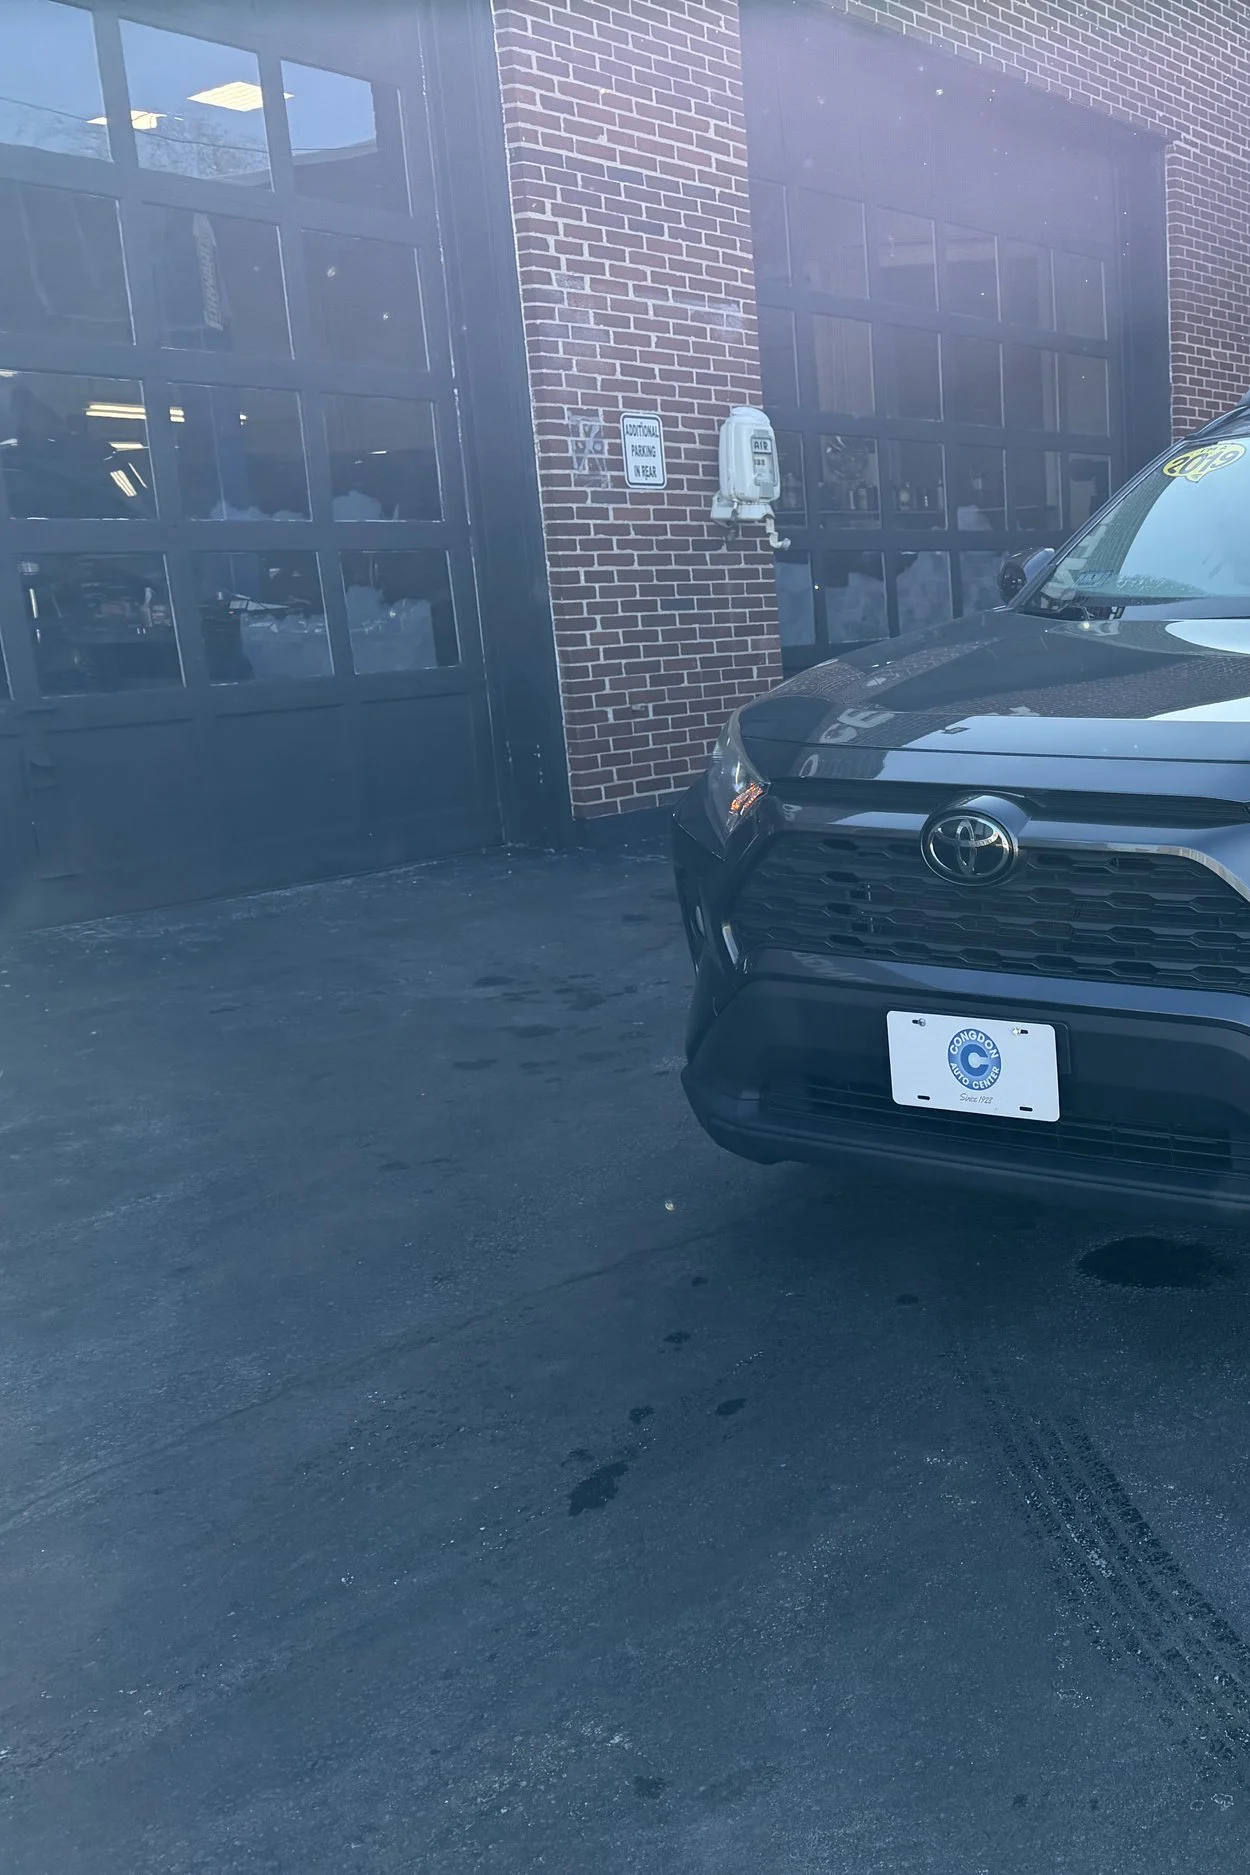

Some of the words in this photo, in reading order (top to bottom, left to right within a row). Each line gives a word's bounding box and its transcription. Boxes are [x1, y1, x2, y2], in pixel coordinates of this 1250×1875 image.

[625, 423, 659, 438] ADDITIONAL
[631, 444, 656, 458] PARKING
[754, 440, 768, 450] AIR
[1167, 450, 1240, 474] 2019
[634, 465, 640, 478] IN
[641, 465, 657, 478] REAR
[950, 1030, 999, 1059] CONGDON
[960, 1043, 989, 1077] C
[950, 1062, 969, 1085] AUTO
[972, 1066, 1000, 1089] CENTER
[959, 1092, 978, 1103] Since
